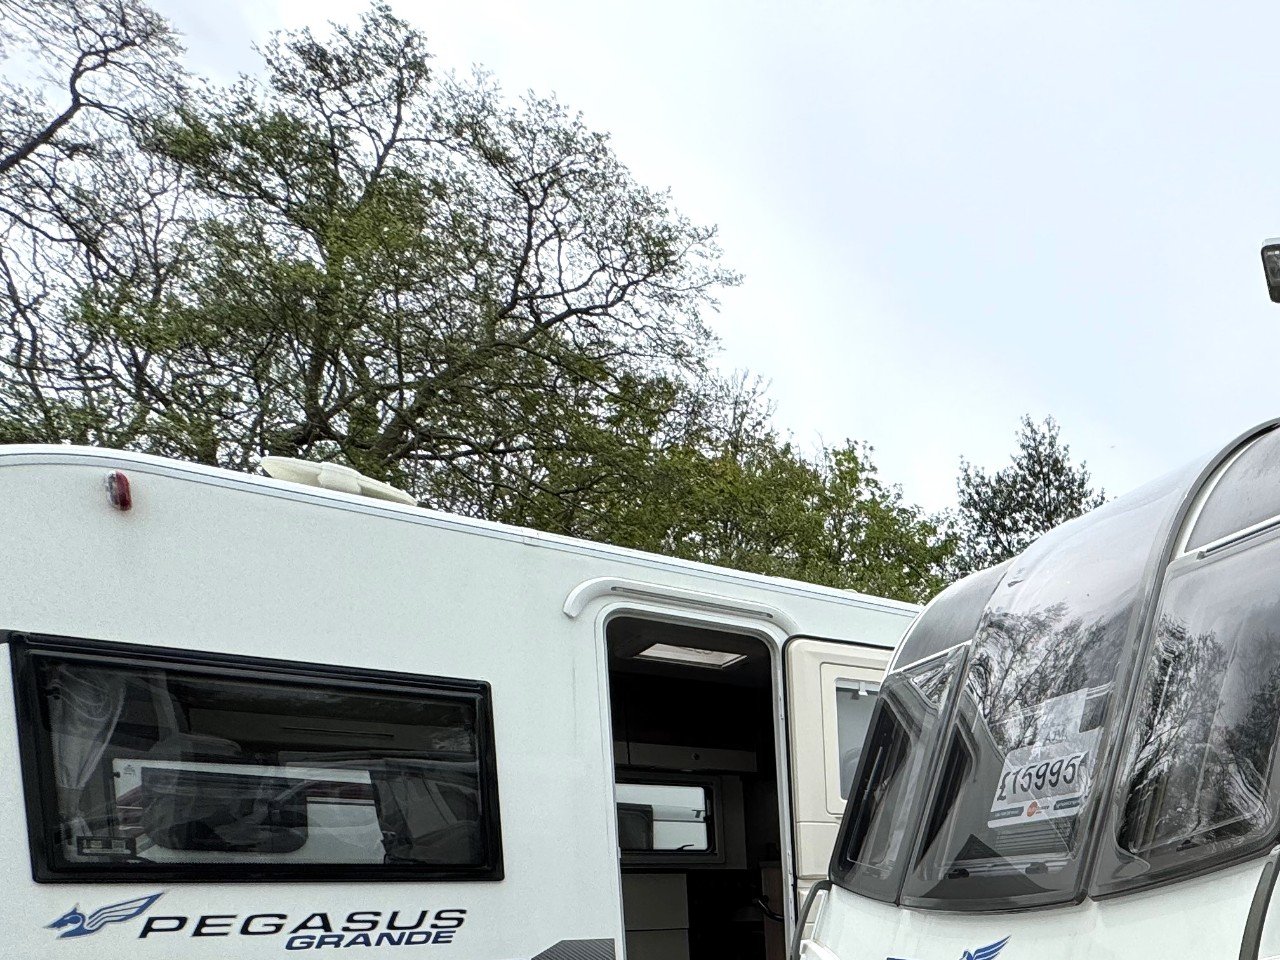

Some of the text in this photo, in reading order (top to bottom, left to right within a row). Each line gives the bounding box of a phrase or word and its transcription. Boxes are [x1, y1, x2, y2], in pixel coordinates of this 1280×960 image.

[996, 755, 1081, 801] £15995
[138, 909, 467, 938] PEGASUS
[285, 930, 457, 950] GRANDE
